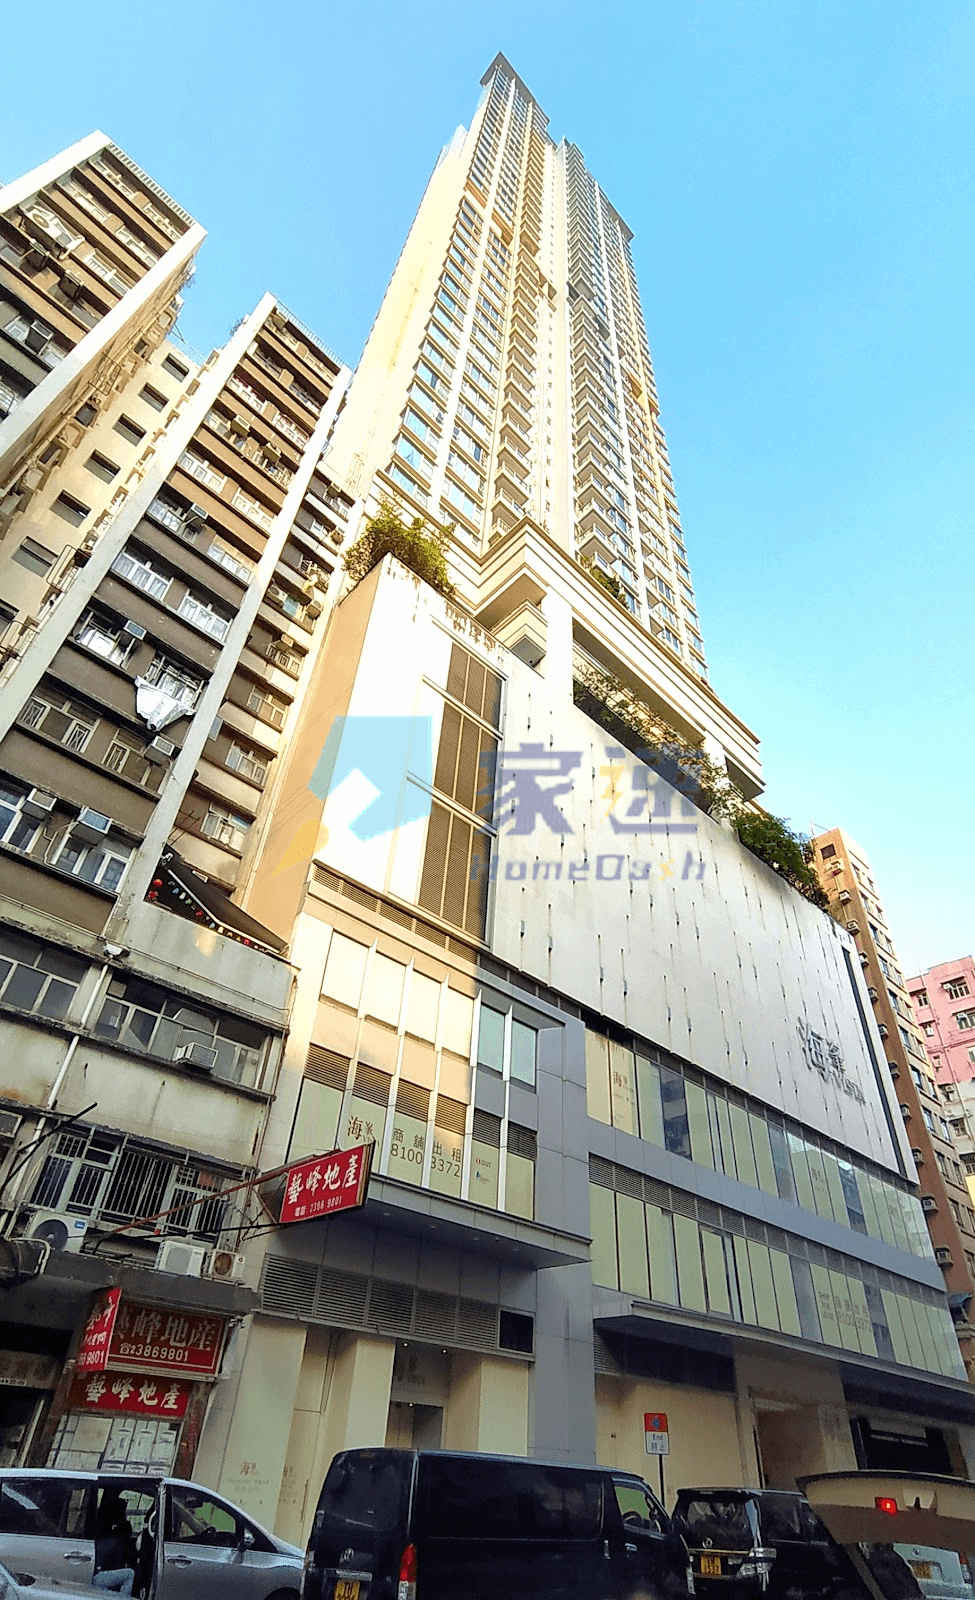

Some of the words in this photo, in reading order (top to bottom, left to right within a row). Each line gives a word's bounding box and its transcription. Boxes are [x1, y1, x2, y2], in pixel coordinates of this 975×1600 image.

[390, 1143, 423, 1165] 8100
[430, 1155, 461, 1178] 3372
[129, 1343, 189, 1362] 23869801
